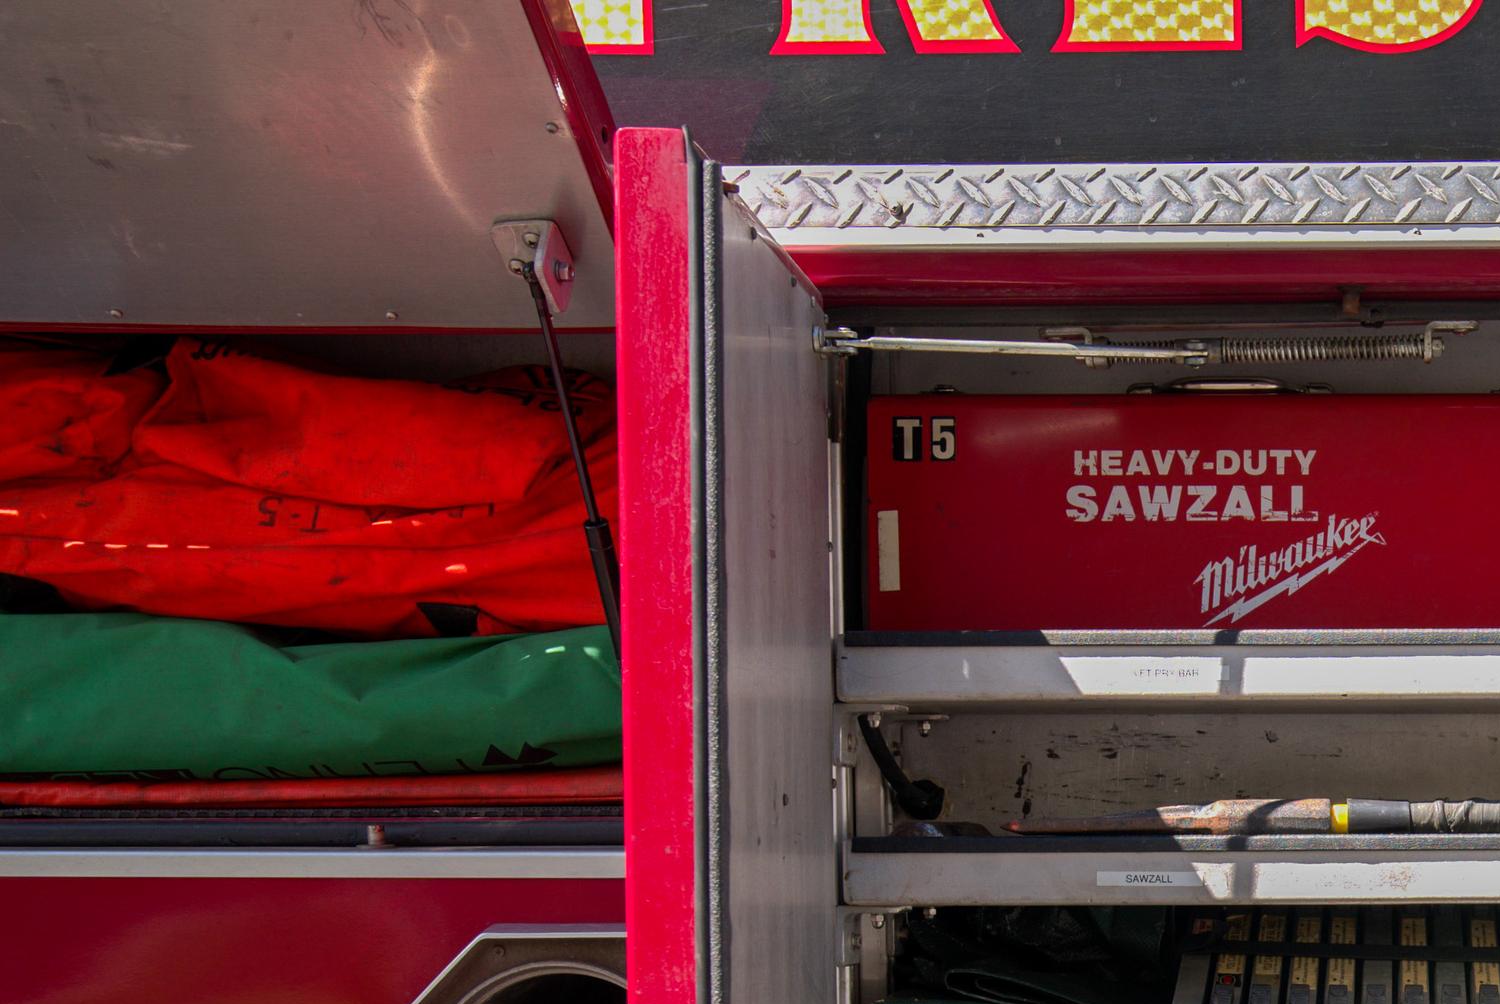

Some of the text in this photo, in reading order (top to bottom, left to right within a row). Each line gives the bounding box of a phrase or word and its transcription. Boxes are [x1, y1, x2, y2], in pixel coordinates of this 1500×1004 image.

[1073, 449, 1318, 476] HEAVY-DUTY
[1065, 484, 1319, 522] SAWZALL
[1193, 513, 1379, 614] Milwaukee
[1125, 874, 1173, 884] SAWZALL
